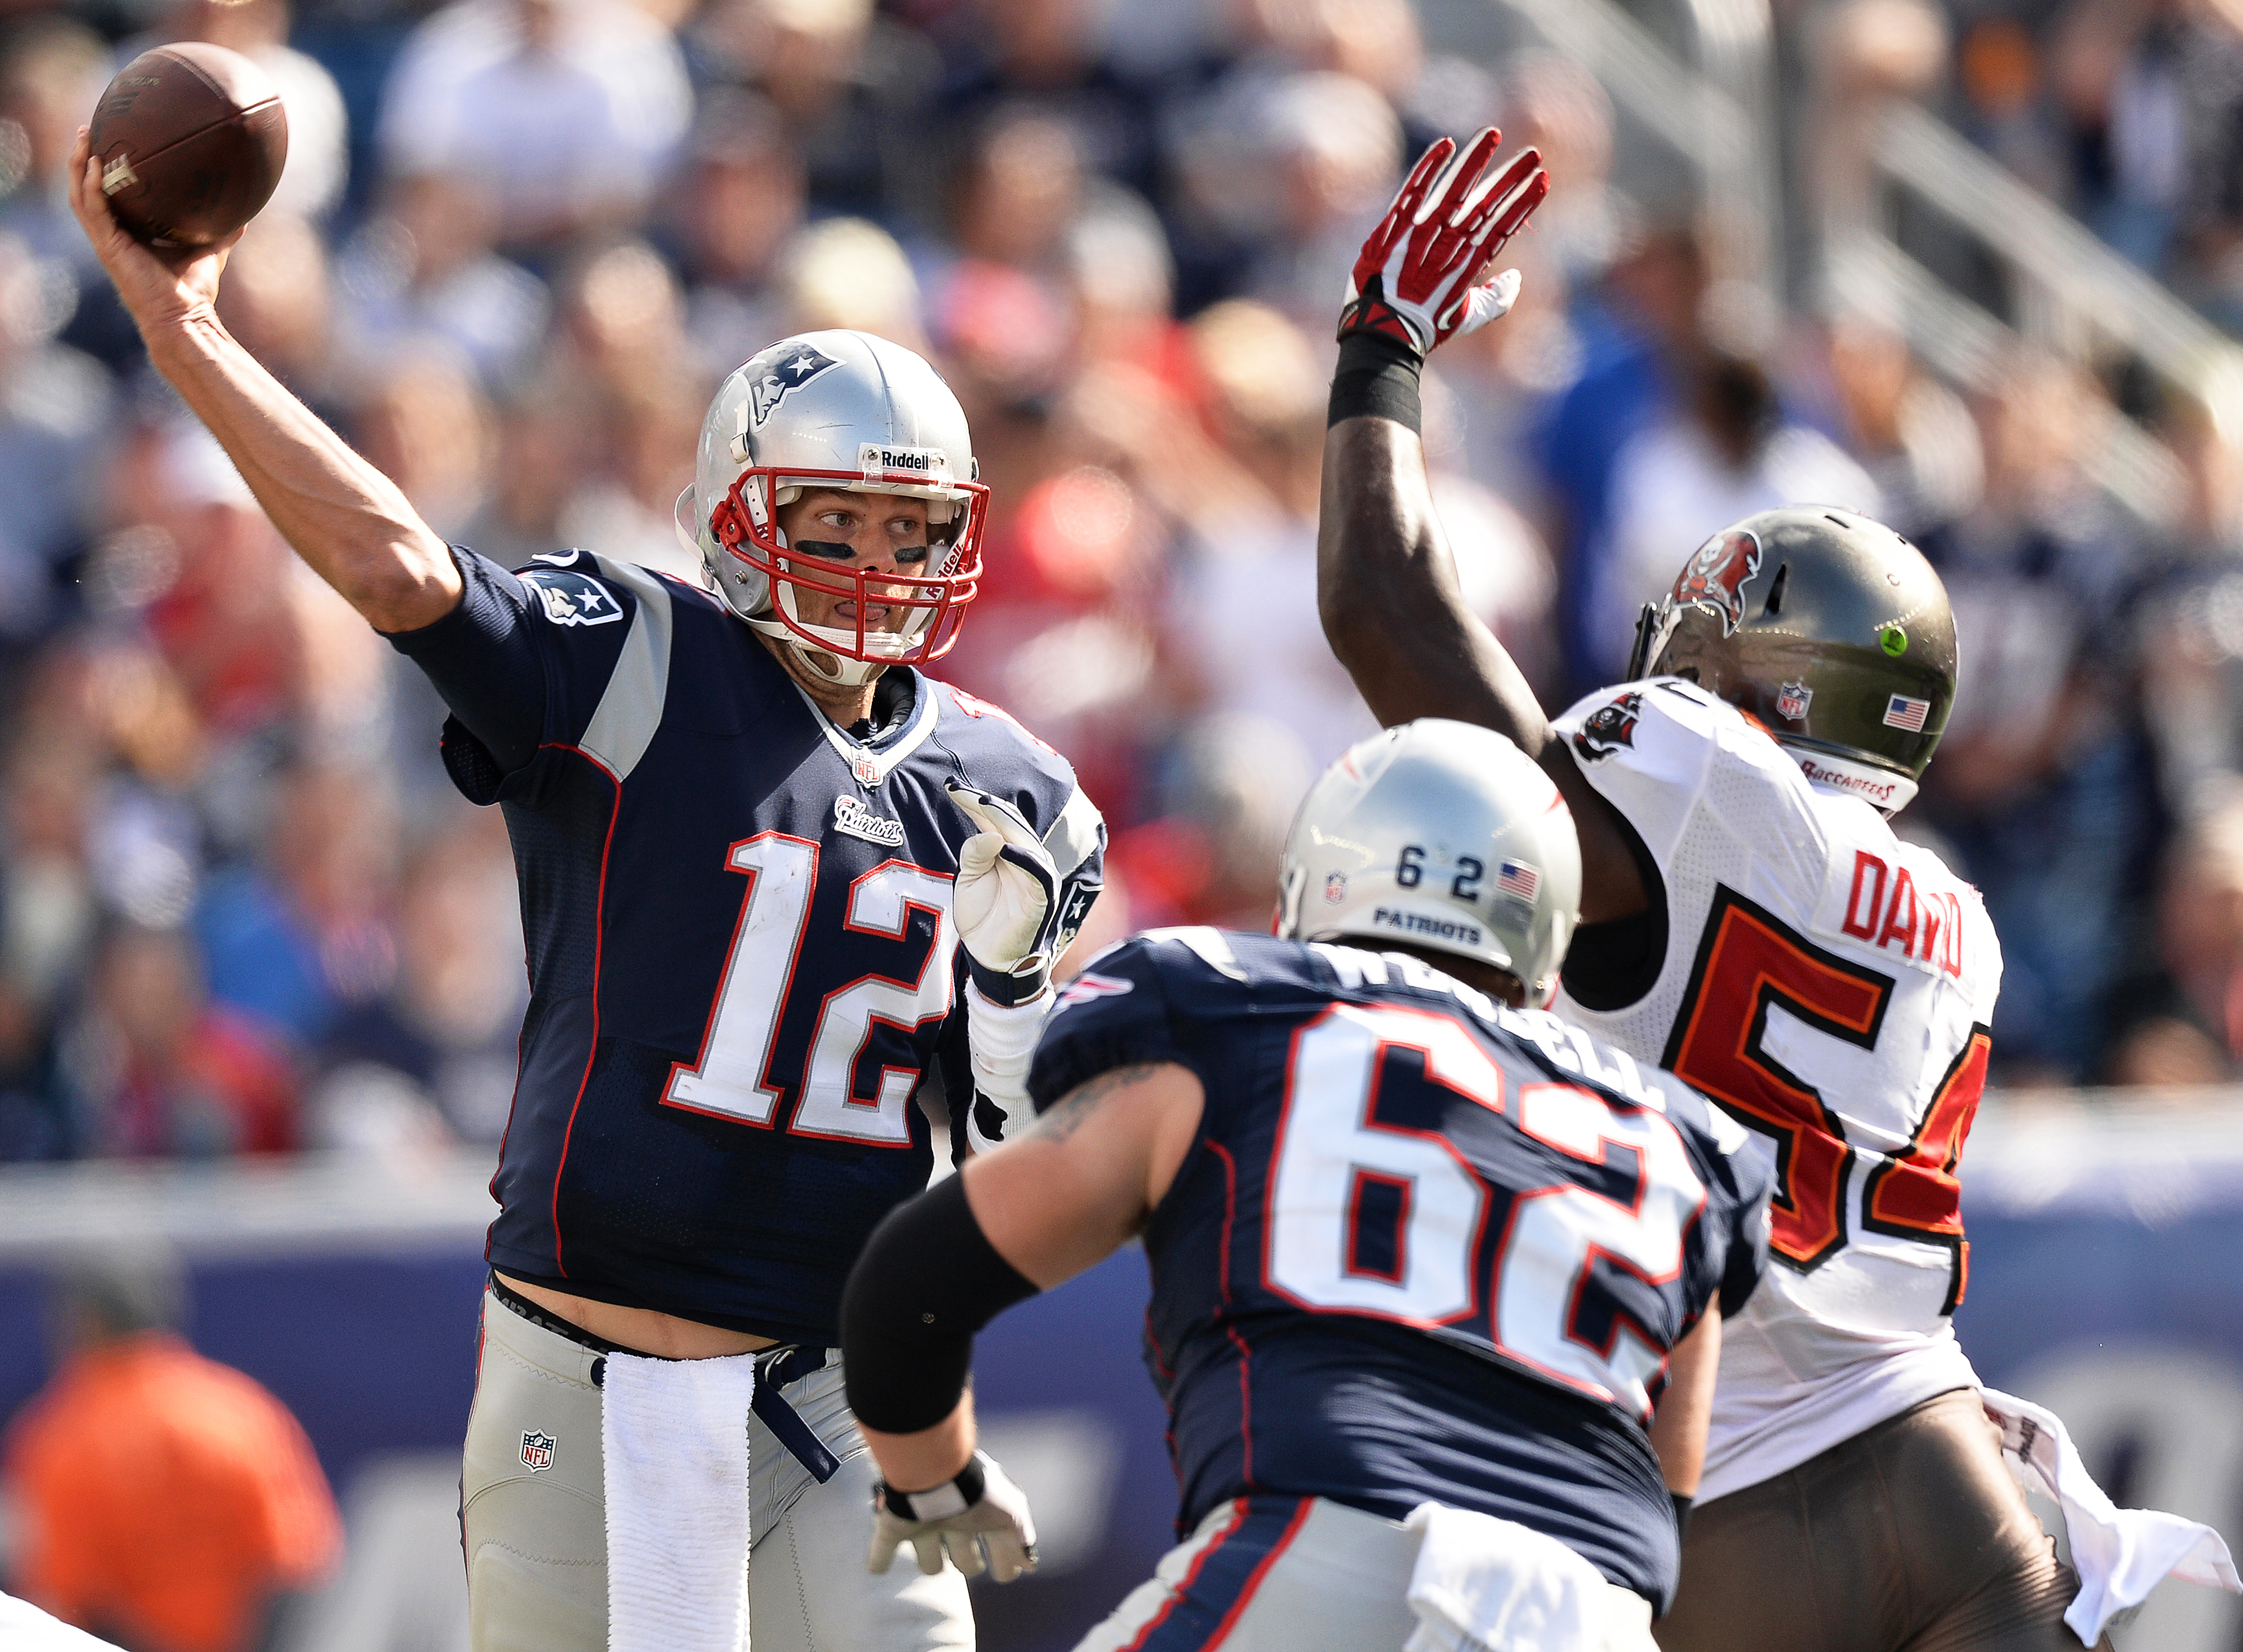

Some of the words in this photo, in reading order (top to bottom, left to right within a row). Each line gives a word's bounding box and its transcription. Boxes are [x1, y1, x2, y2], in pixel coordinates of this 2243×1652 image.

[882, 450, 928, 470] Riddell
[1780, 697, 1804, 715] NFL
[857, 761, 878, 780] NFL
[837, 804, 903, 843] Patriots
[1375, 908, 1481, 945] PATRIOTS
[660, 829, 960, 1149] 12
[1662, 882, 1991, 1316] 54
[1259, 1001, 1707, 1423] 62
[524, 1447, 548, 1465] NFL
